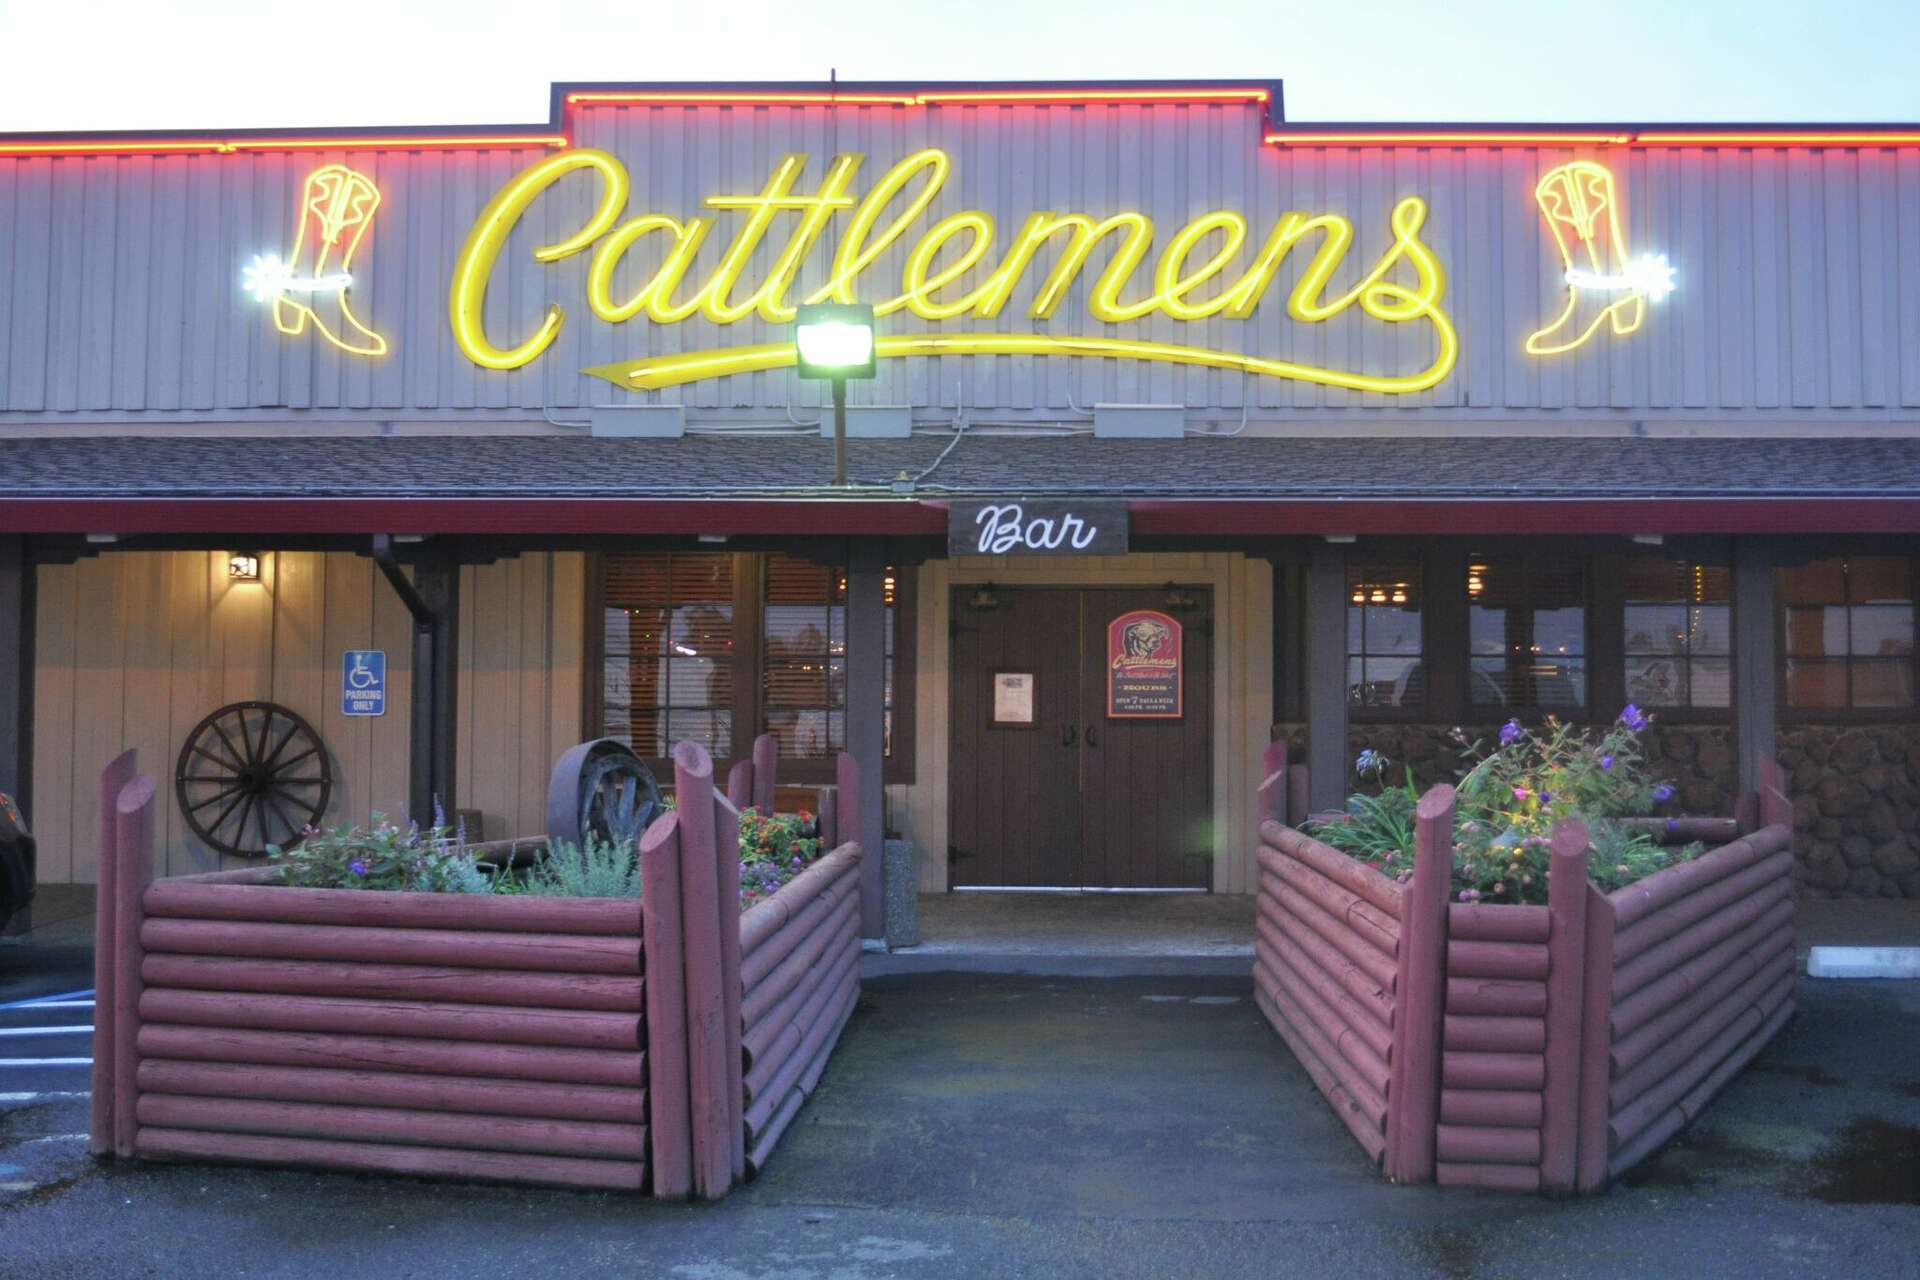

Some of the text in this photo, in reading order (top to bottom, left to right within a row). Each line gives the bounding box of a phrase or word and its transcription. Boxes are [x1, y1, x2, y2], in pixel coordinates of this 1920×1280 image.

[449, 147, 1458, 394] Cattlemens
[976, 504, 1097, 553] Bar
[1112, 654, 1177, 669] Cattlemens
[345, 690, 382, 700] PARKING
[353, 701, 374, 711] ONLY
